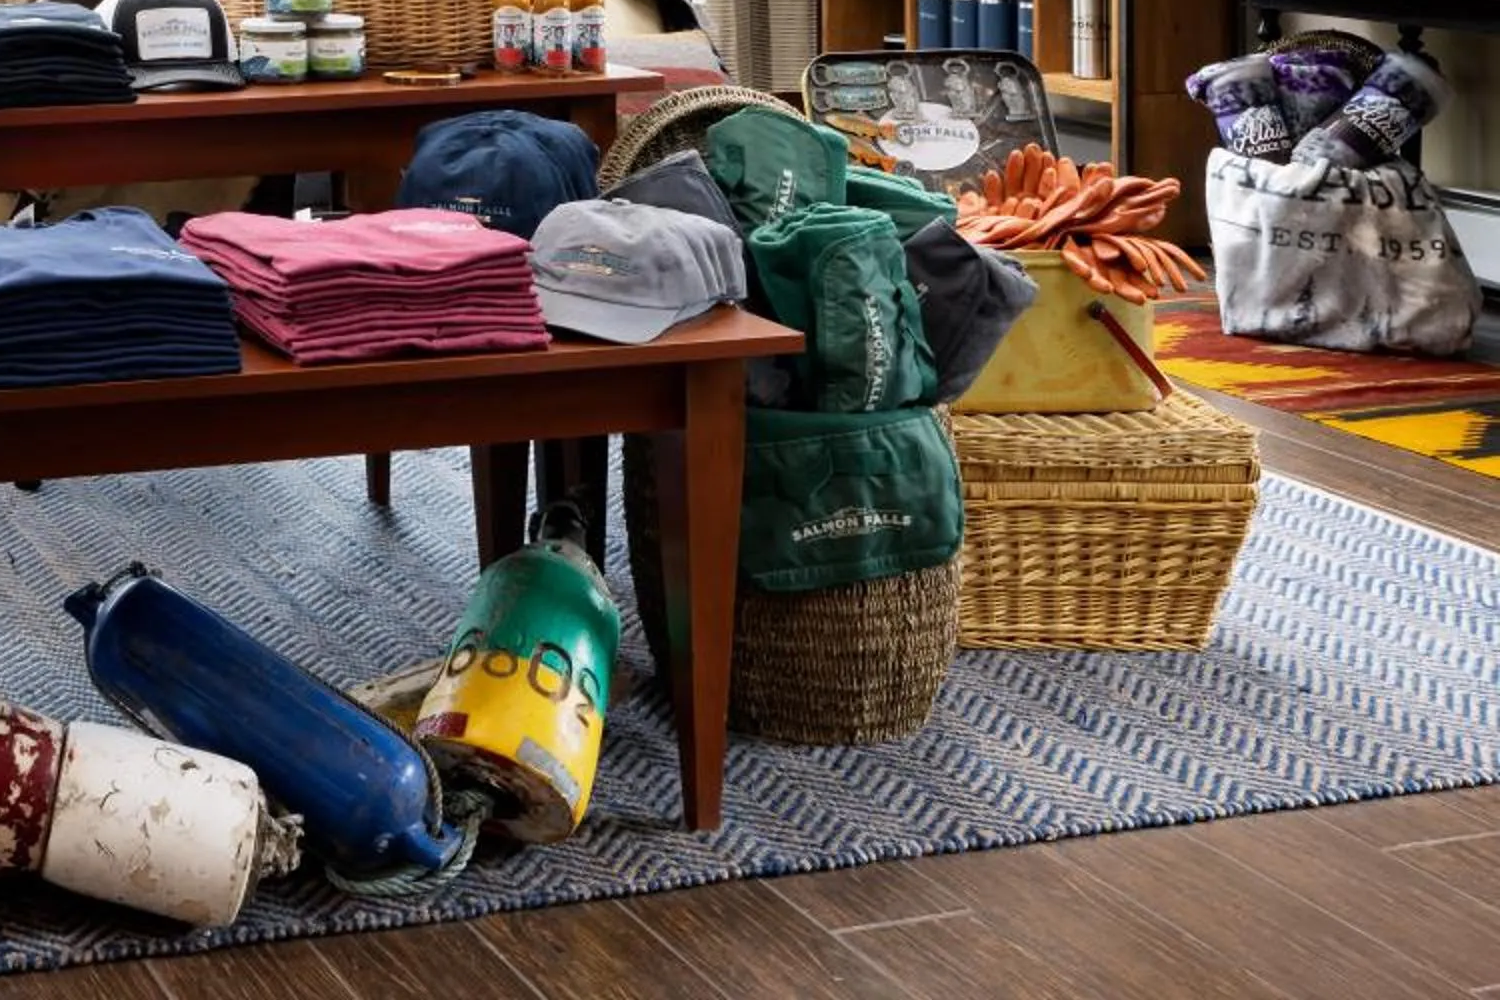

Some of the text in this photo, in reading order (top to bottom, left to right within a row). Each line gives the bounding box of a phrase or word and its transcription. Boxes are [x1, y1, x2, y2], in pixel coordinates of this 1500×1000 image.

[1377, 237, 1446, 262] 1959
[791, 513, 912, 542] SALMON FALLS
